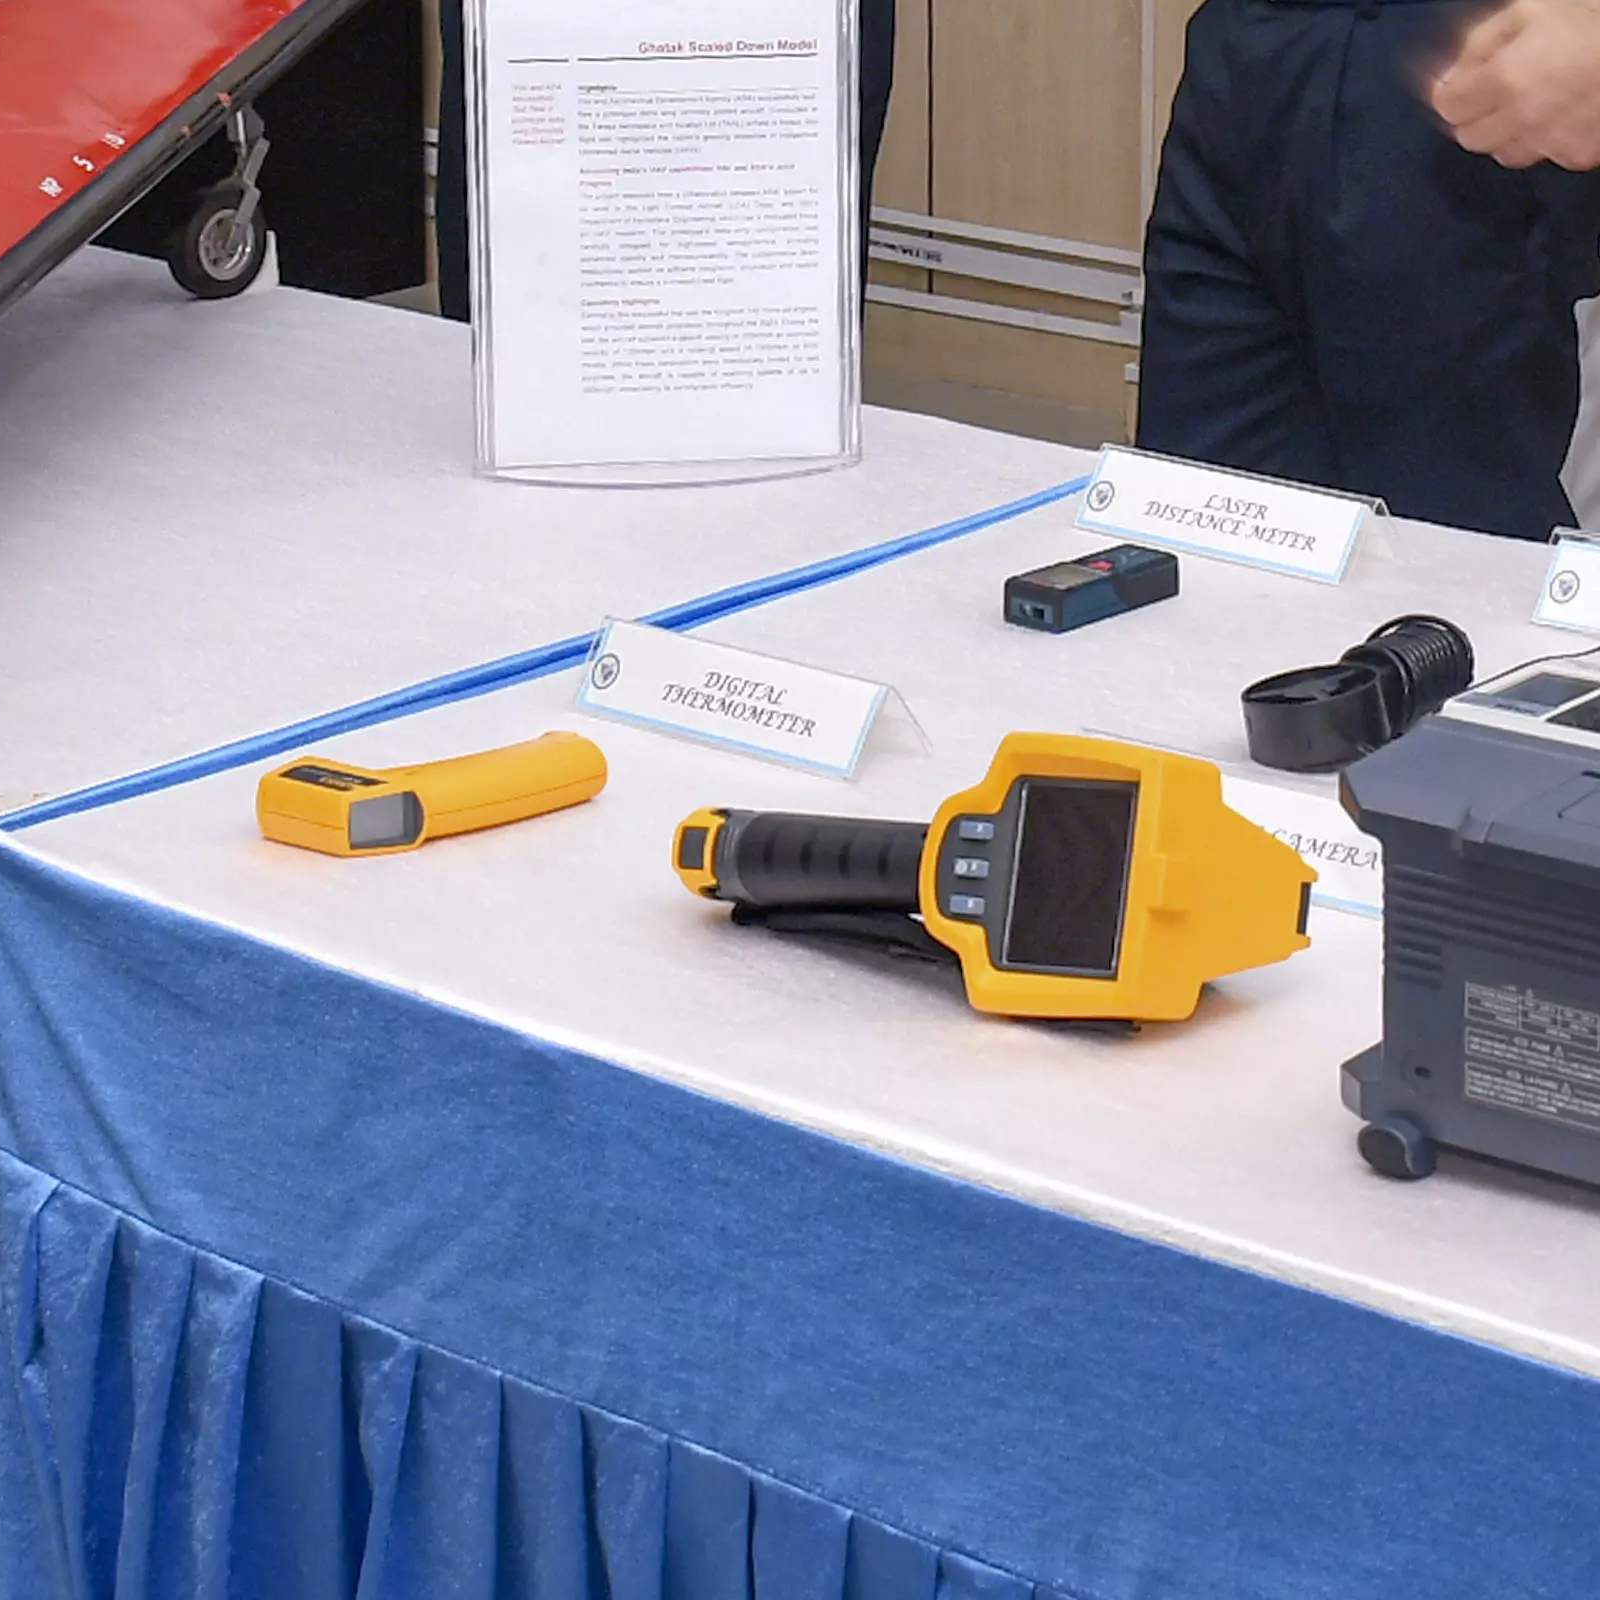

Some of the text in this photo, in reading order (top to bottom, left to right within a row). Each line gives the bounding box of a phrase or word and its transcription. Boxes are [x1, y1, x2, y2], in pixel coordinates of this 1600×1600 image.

[688, 41, 734, 52] Scaled
[736, 40, 775, 51] Down
[777, 39, 818, 51] Model
[1203, 494, 1268, 521] LASER
[1143, 500, 1316, 552] DISTANCE METER
[704, 671, 789, 706] DIGITAL
[661, 683, 818, 738] THERMOMETER
